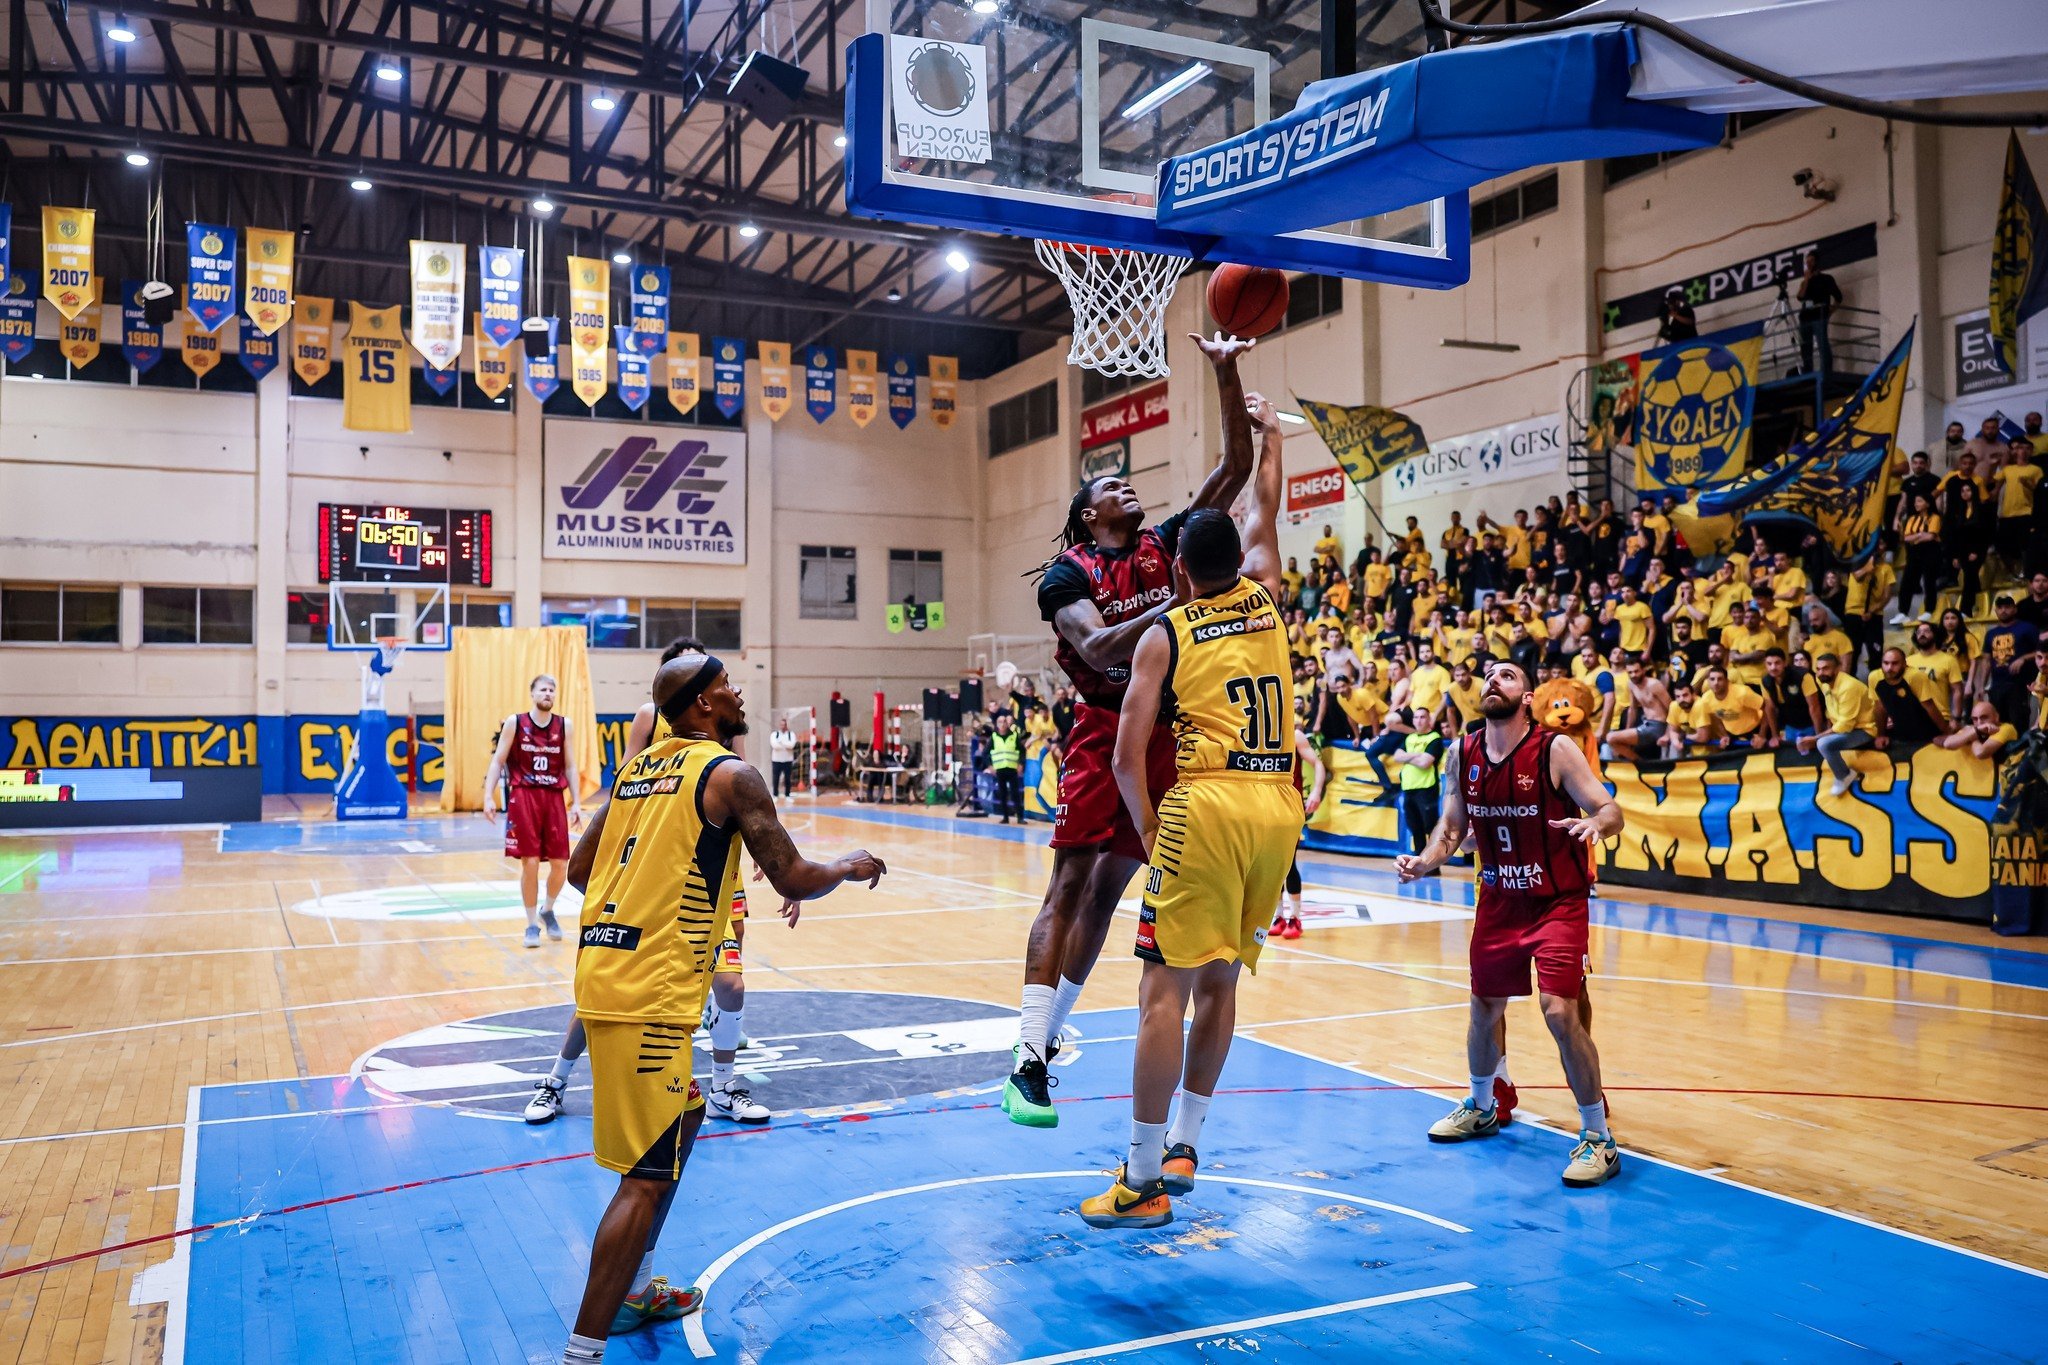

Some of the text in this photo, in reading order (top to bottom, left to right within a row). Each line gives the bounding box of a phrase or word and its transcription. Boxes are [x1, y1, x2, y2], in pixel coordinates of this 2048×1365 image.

[1173, 88, 1390, 196] SPORTSYSTEM
[191, 256, 233, 272] SUPER CUP
[50, 269, 90, 287] 2007
[192, 282, 231, 302] 2007
[251, 286, 287, 305] 2008
[484, 302, 518, 321] 2008
[574, 312, 605, 329] 2009
[0, 320, 33, 337] 1978
[64, 326, 97, 341] 1978
[633, 316, 665, 334] 2009
[127, 332, 159, 347] 1980
[186, 335, 217, 350] 1980
[245, 340, 273, 355] 1981
[298, 344, 327, 360] 1982
[359, 349, 395, 384] 15
[1422, 446, 1472, 477] GFSC
[1668, 455, 1703, 475] 1989
[1290, 472, 1342, 499] ENEOS
[557, 513, 733, 537] MUSKITA
[361, 523, 418, 547] 06:50
[557, 534, 734, 553] ALUMINIUM INDUSTRIES
[389, 545, 403, 565] 4
[1100, 585, 1172, 618] ERAVNOS
[1225, 674, 1283, 750] 30
[7, 718, 258, 769] ΑΘΛΗΤΙΚΗ
[533, 755, 549, 771] 20
[1497, 825, 1513, 852] 9
[1498, 862, 1543, 878] NIVEA
[1146, 865, 1163, 896] 30
[1502, 874, 1543, 890] MEN
[666, 1085, 684, 1093] VAAT
